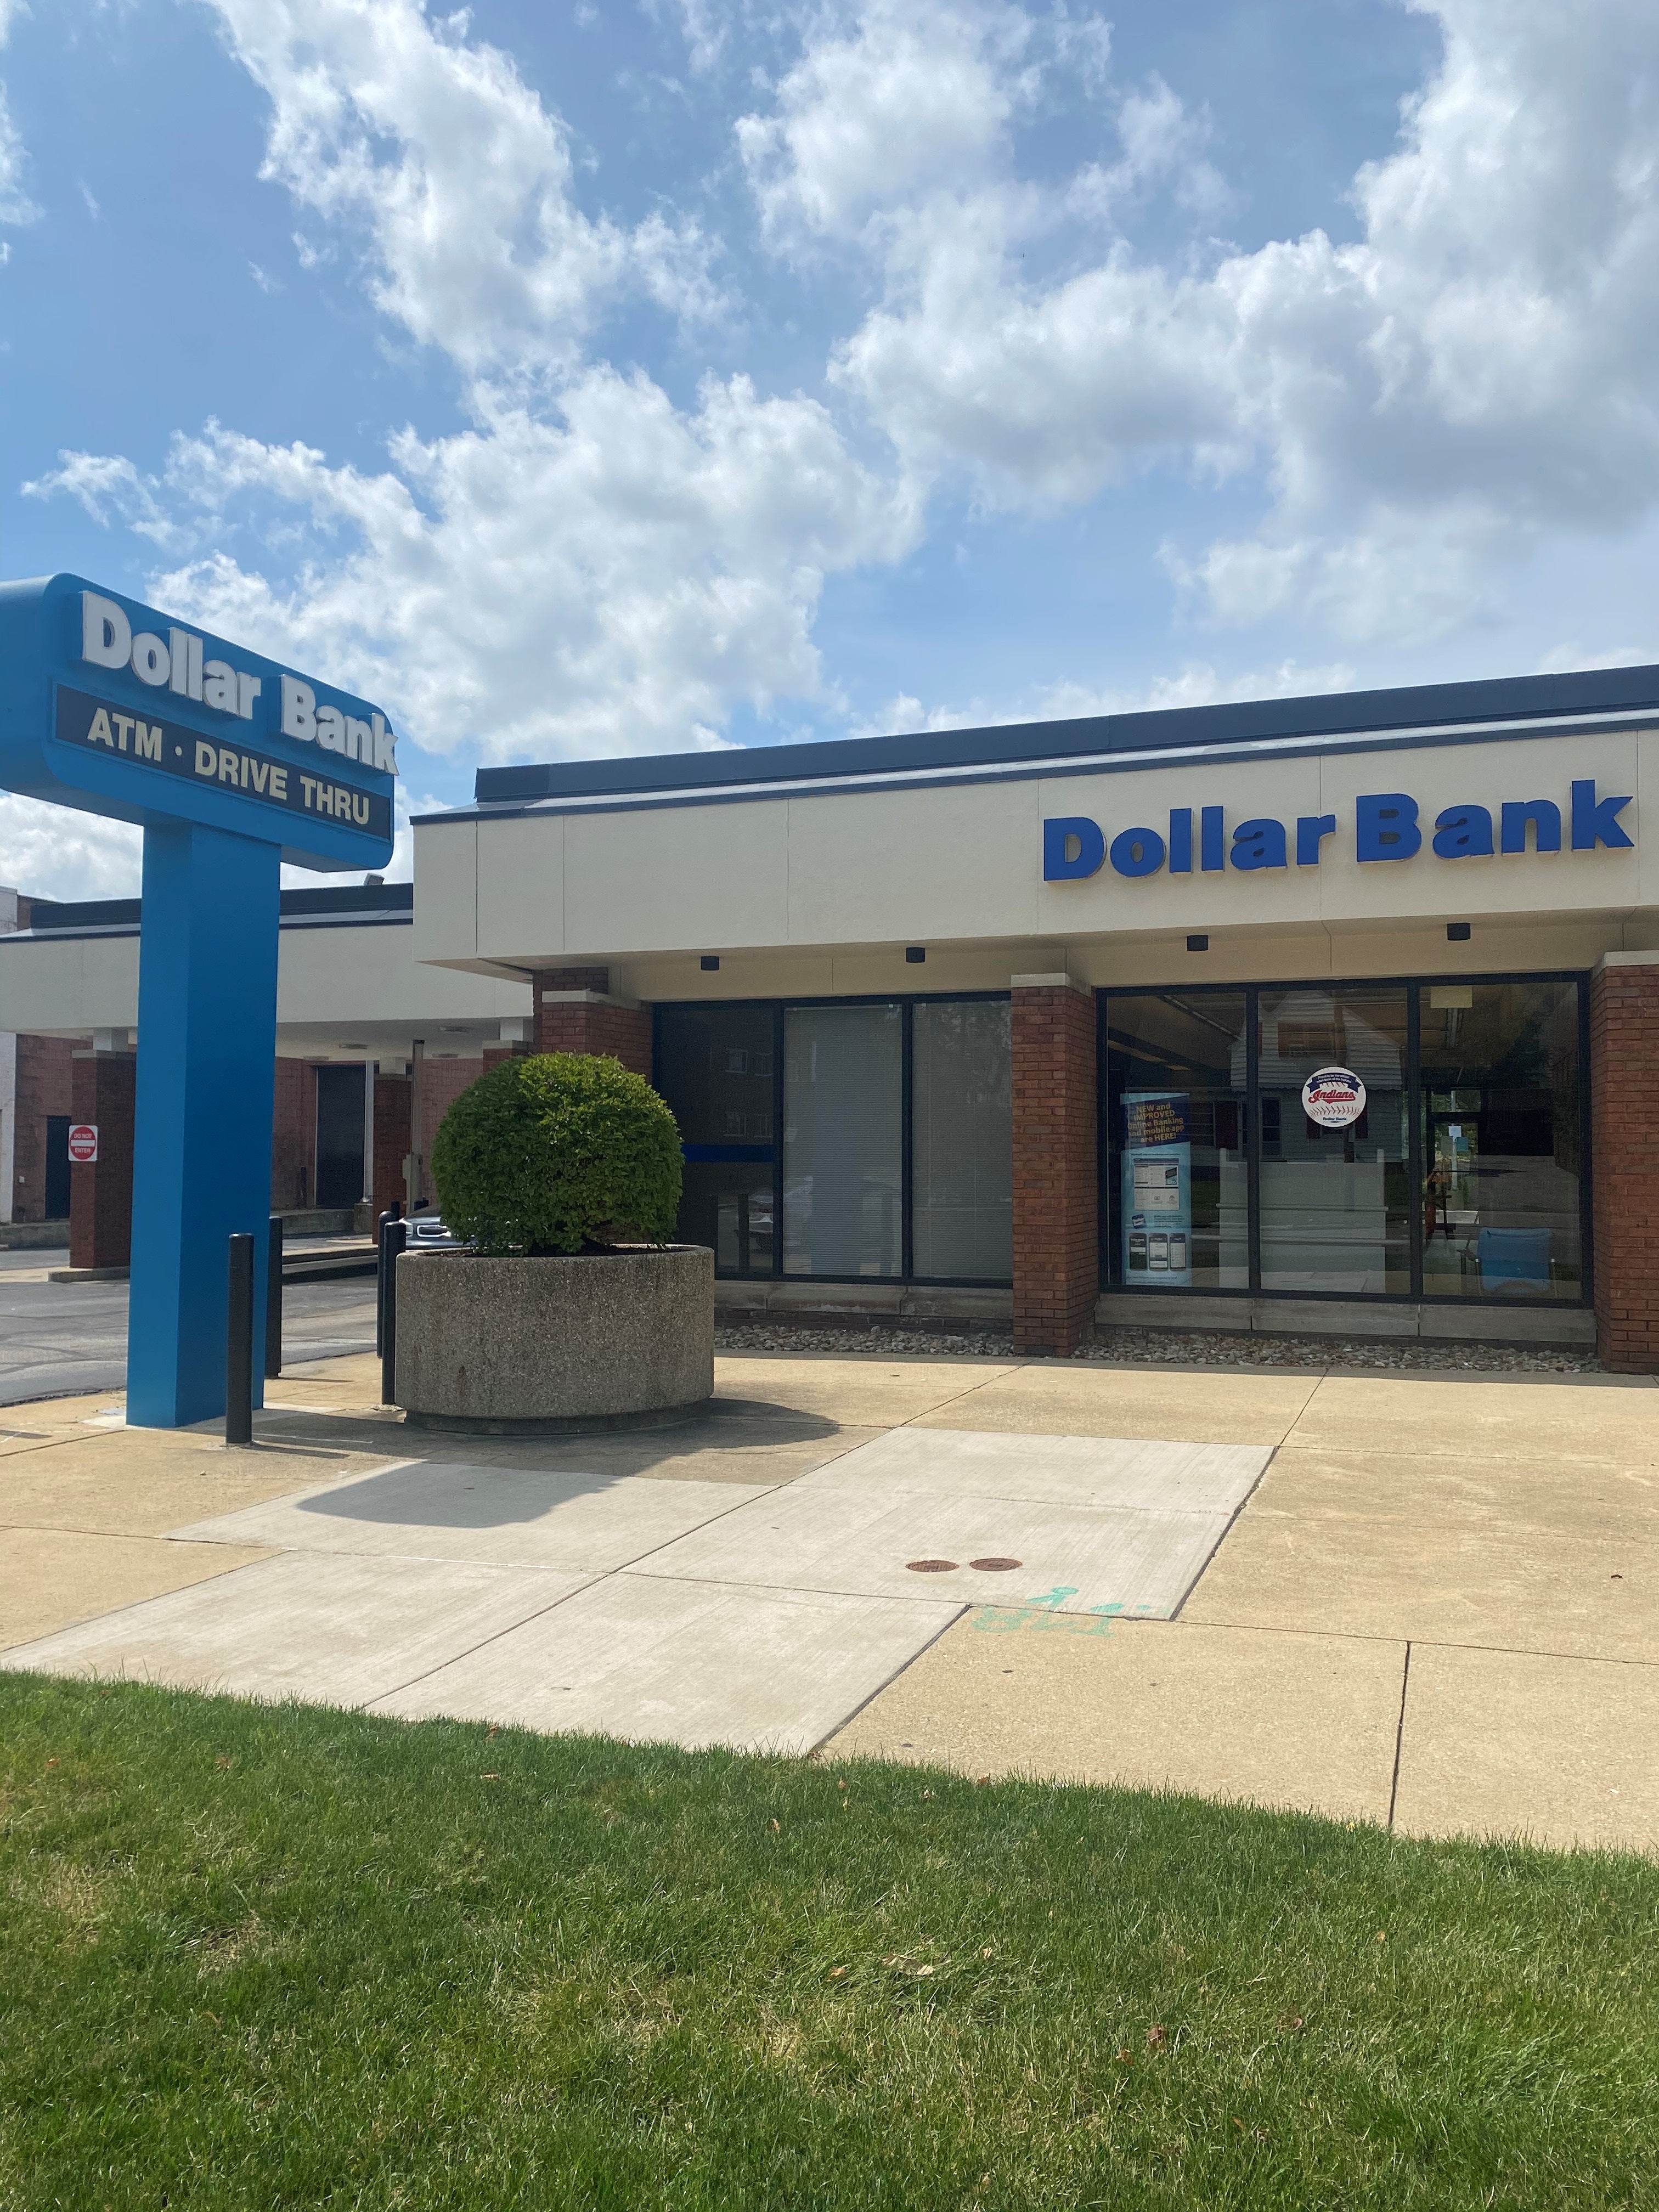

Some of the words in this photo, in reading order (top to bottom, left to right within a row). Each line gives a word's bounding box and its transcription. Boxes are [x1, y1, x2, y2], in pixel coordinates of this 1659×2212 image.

[82, 590, 261, 720] Dollar
[280, 674, 400, 776] Bank
[87, 707, 163, 763] ATM
[195, 740, 287, 801] DRIVE
[300, 775, 370, 825] THRU
[1043, 805, 1336, 882] Dollar
[1356, 779, 1634, 864] Bank
[1308, 1090, 1356, 1104] Indians
[1136, 1104, 1154, 1113] NEW
[1156, 1102, 1171, 1110] and
[1133, 1109, 1175, 1121] IMPROVED
[1153, 1118, 1183, 1126] Banking
[1143, 1126, 1170, 1135] mobile
[1154, 1132, 1176, 1142] HERE!
